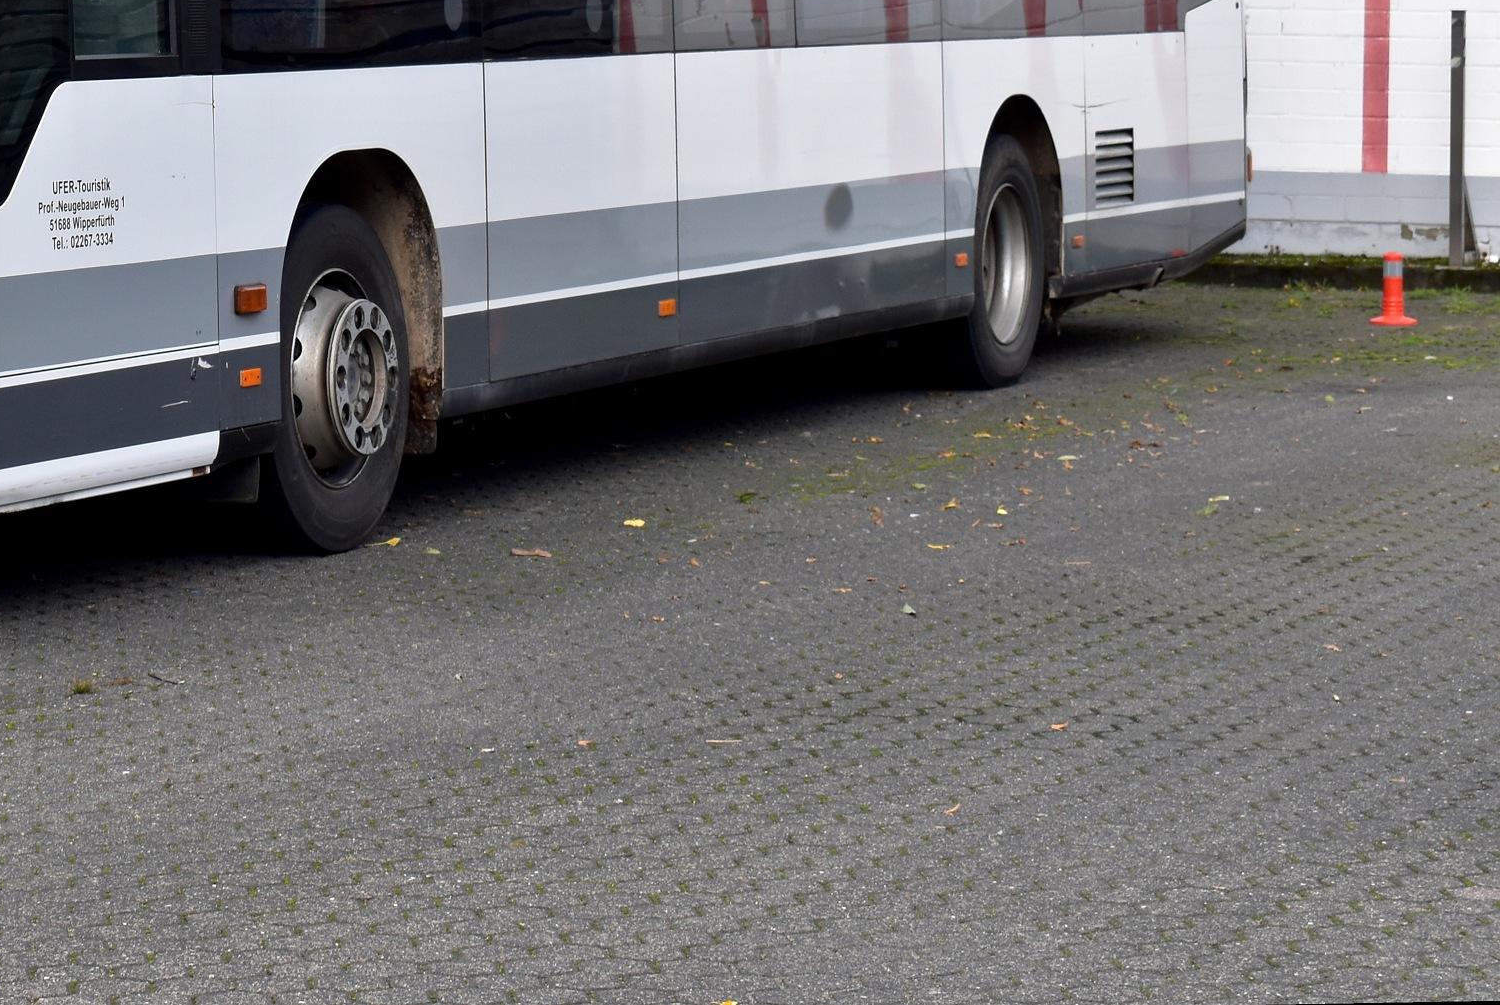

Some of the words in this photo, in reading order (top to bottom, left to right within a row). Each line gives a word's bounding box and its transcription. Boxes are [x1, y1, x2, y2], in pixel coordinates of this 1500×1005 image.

[52, 177, 111, 195] UFER-Touristik
[38, 196, 119, 215] Prof.-Neugebauer-Weg
[121, 195, 125, 208] 1
[49, 217, 71, 231] 51688
[72, 214, 115, 231] Wipperfürth
[51, 236, 69, 250] Tel.:
[70, 232, 114, 248] 02267-3334
